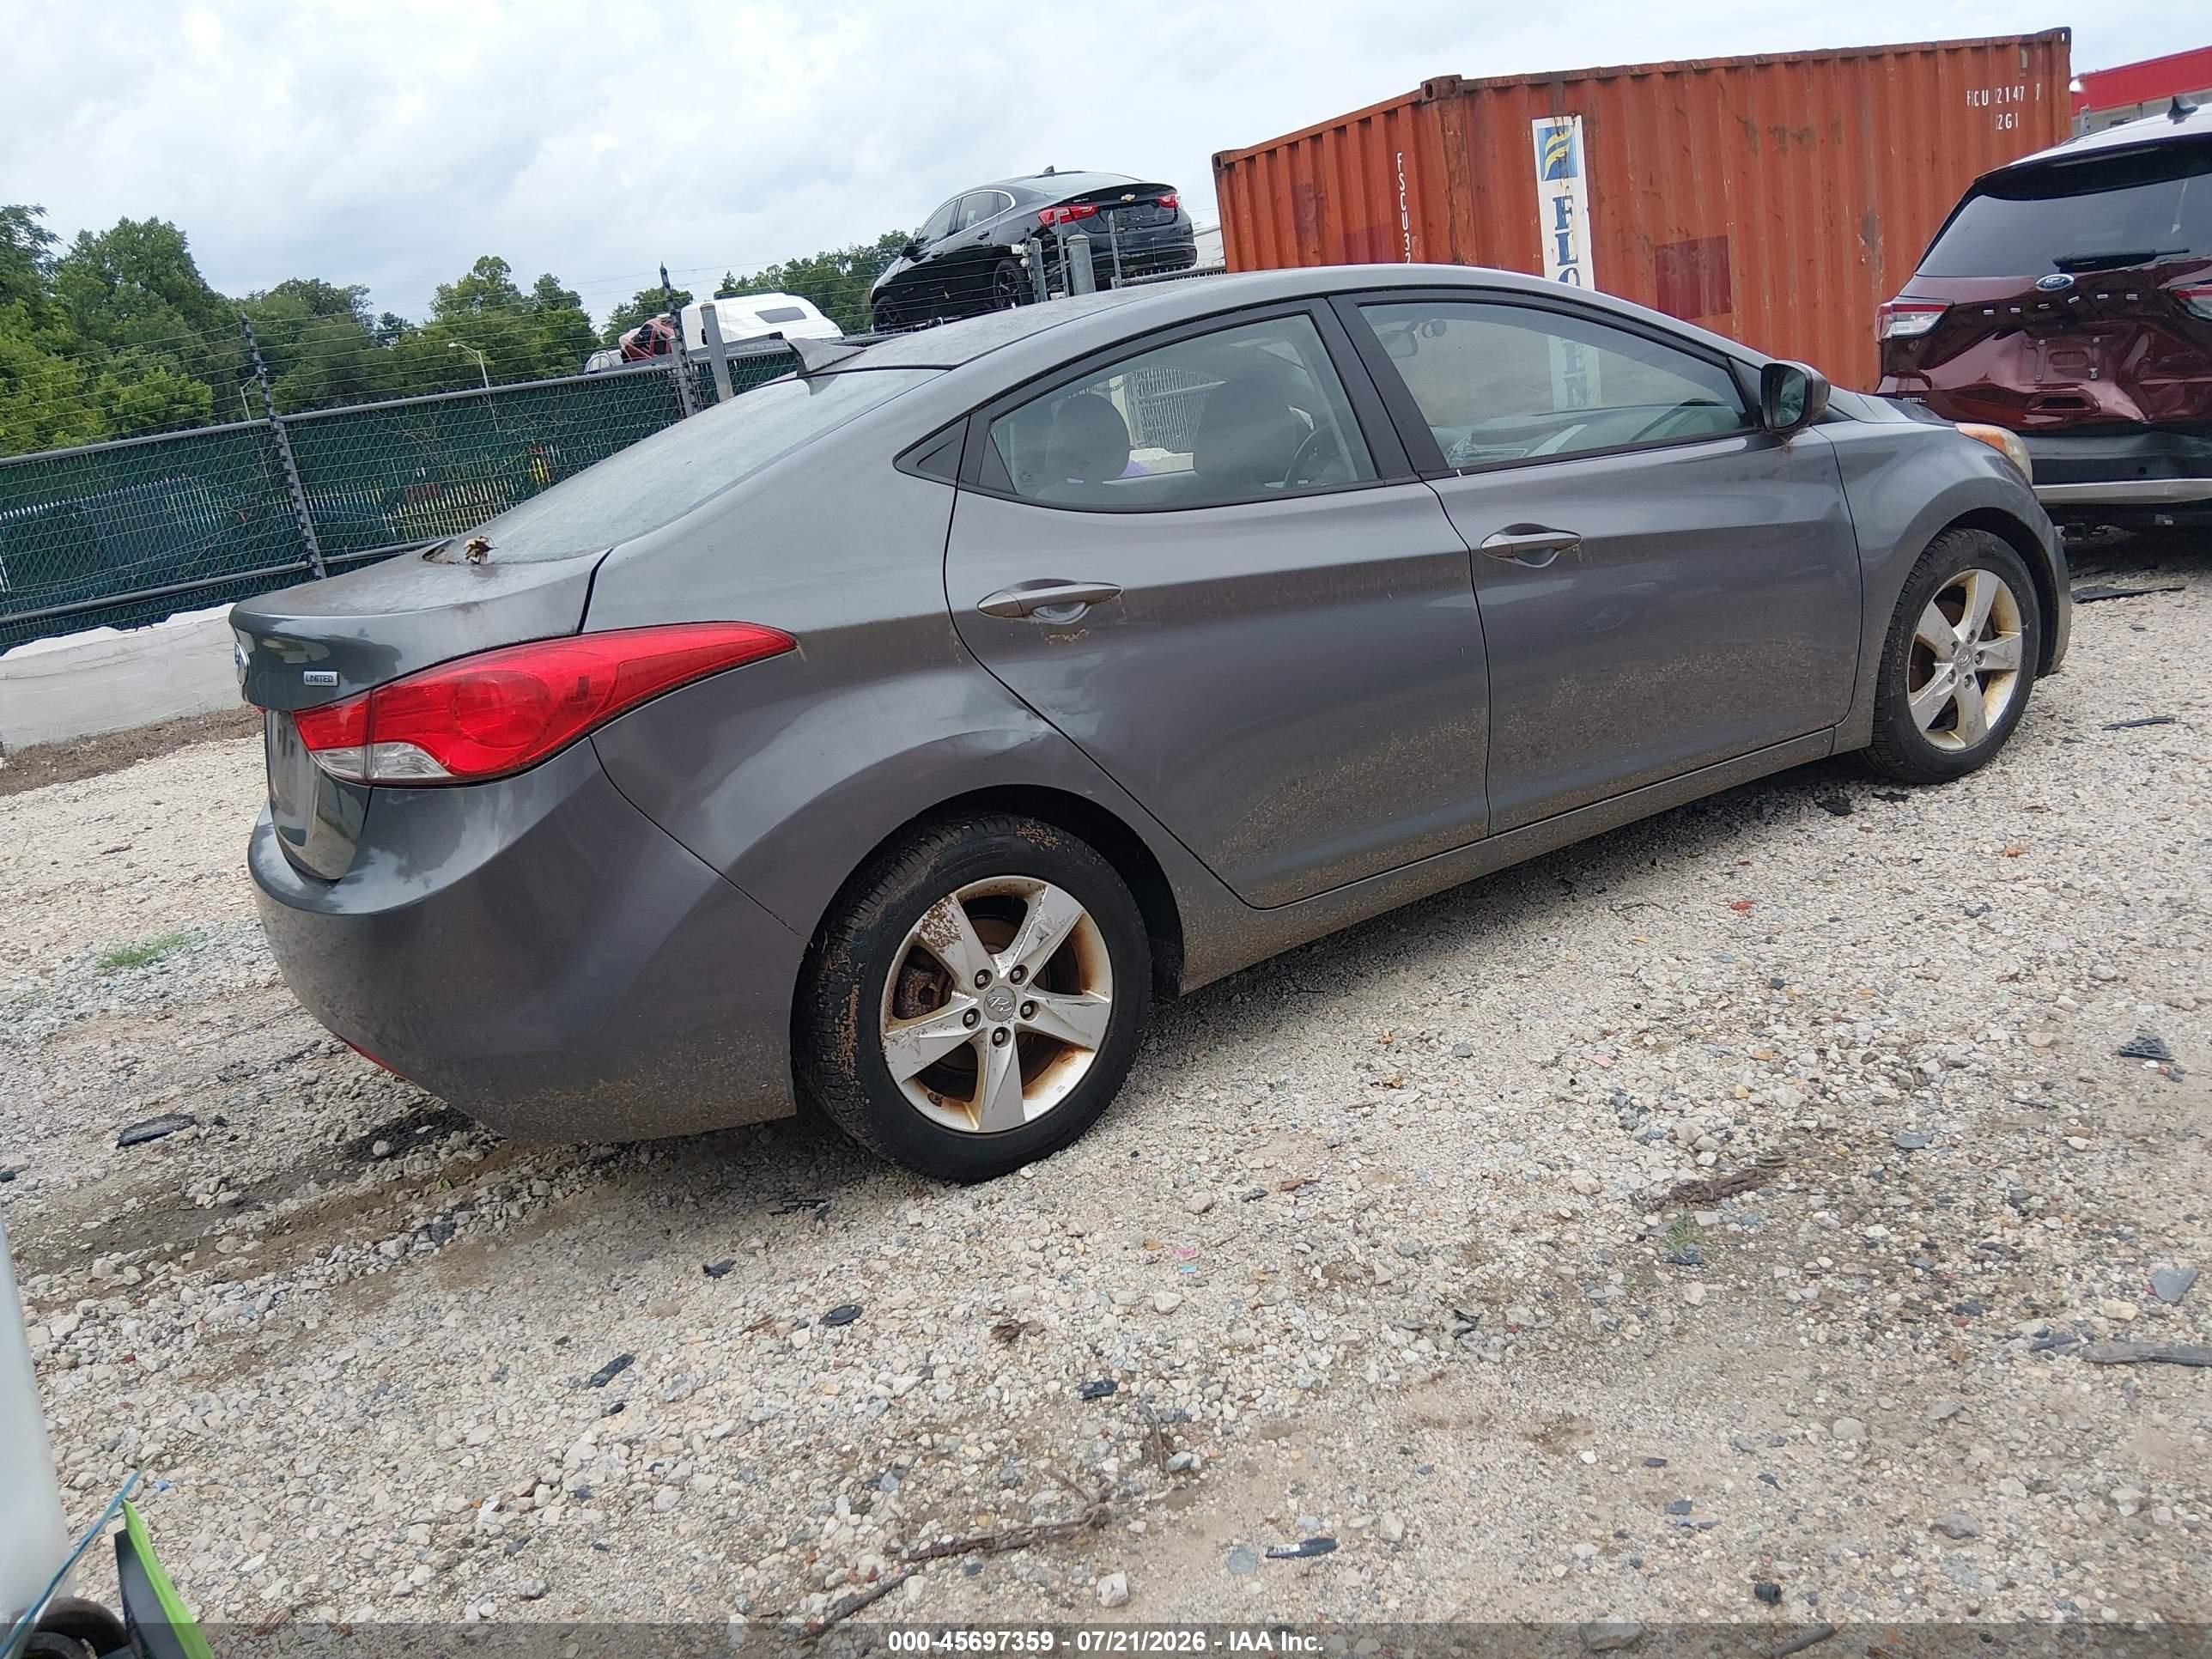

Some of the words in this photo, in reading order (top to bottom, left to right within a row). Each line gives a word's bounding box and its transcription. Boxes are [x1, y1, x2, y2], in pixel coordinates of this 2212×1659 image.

[1966, 89, 1990, 106] FCU
[1995, 85, 2025, 104] 2147
[1996, 112, 2019, 131] 2G1
